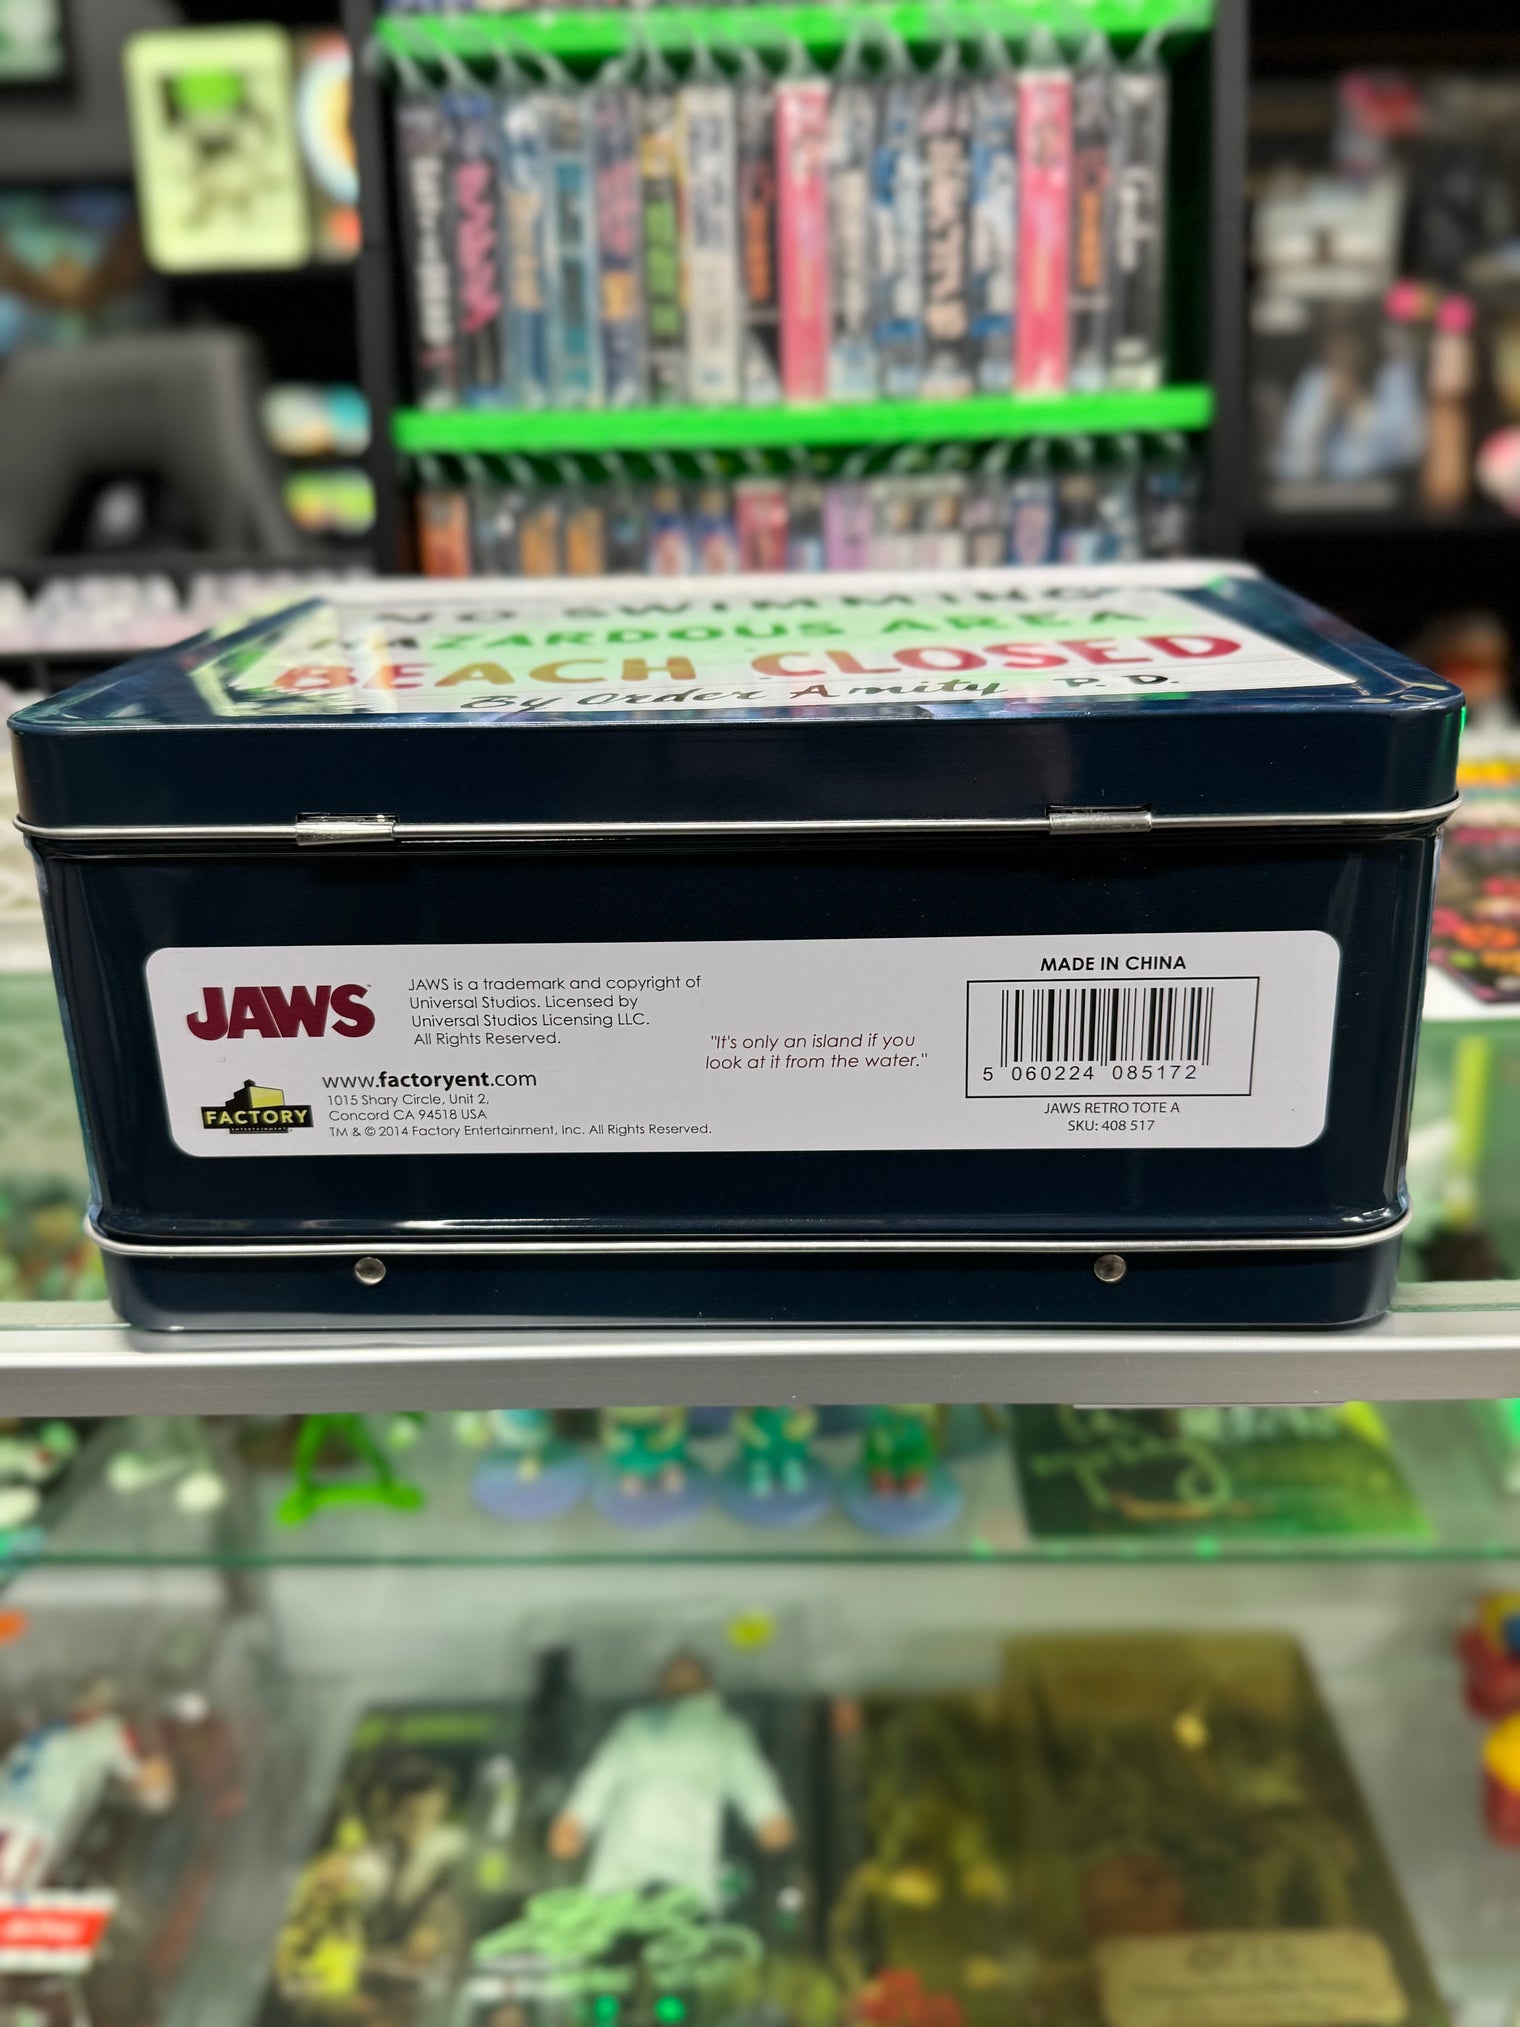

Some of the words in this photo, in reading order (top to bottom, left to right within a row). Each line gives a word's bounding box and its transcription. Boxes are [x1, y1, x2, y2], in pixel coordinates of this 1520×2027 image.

[373, 609, 518, 624] NO
[880, 610, 1146, 634] AREA
[273, 656, 697, 691] BEACH
[751, 634, 1243, 677] CLOSED
[460, 695, 562, 712] By
[577, 687, 767, 705] Order
[789, 677, 1009, 700] Amity
[1040, 957, 1095, 972] MADE
[1101, 956, 1120, 971] IN
[1125, 955, 1188, 971] CHINA
[408, 978, 449, 992] JAWS
[453, 978, 463, 991] is
[467, 981, 479, 991] a
[483, 977, 566, 991] trademark
[569, 976, 601, 990] and
[605, 975, 681, 992] copyright
[685, 974, 702, 989] of
[410, 996, 477, 1010] Universal
[482, 996, 541, 1009] Studios.
[545, 995, 614, 1008] Licensed
[618, 995, 638, 1011] by
[186, 983, 376, 1041] JAWS
[412, 1014, 480, 1028] Universal
[483, 1013, 538, 1027] Studios
[542, 1012, 613, 1029] Licensing
[617, 1012, 650, 1026] LLC.
[413, 1033, 432, 1046] All
[436, 1032, 481, 1048] Rights
[486, 1031, 561, 1045] Reserved.
[711, 1034, 738, 1049] "It's
[742, 1035, 779, 1052] only
[784, 1037, 808, 1049] an
[812, 1033, 863, 1048] island
[867, 1033, 878, 1048] if
[882, 1035, 916, 1050] you
[705, 1056, 742, 1070] look
[747, 1055, 766, 1069] at
[770, 1055, 781, 1069] it
[785, 1055, 825, 1069] from
[831, 1054, 860, 1068] the
[864, 1053, 928, 1068] water."
[321, 1071, 537, 1092] www.factoryent.com
[983, 1067, 994, 1081] 5
[1011, 1066, 1095, 1081] 060224
[1112, 1065, 1197, 1080] 085172
[328, 1095, 358, 1106] 1015
[361, 1094, 399, 1107] Shary
[402, 1093, 446, 1106] Circle,
[449, 1093, 474, 1105] Unit
[477, 1093, 491, 1105] 2,
[1043, 1102, 1081, 1115] JAWS
[1084, 1102, 1129, 1114] RETRO
[1132, 1102, 1165, 1114] TOTE
[1169, 1102, 1181, 1113] A
[205, 1109, 308, 1125] FACTORY
[329, 1109, 390, 1121] Concord
[393, 1109, 415, 1121] CA
[419, 1109, 458, 1120] 94518
[461, 1109, 488, 1120] USA
[329, 1126, 349, 1137] TM
[352, 1126, 362, 1137] &
[378, 1126, 409, 1137] 2014
[412, 1125, 461, 1138] Factory
[464, 1124, 558, 1138] Entertainment,
[561, 1124, 586, 1136] Inc.
[589, 1124, 604, 1135] All
[607, 1123, 645, 1137] Rights
[649, 1123, 712, 1135] Reserved.
[1067, 1120, 1099, 1132] SKU:
[1101, 1120, 1127, 1132] 408
[1129, 1119, 1156, 1131] 517
